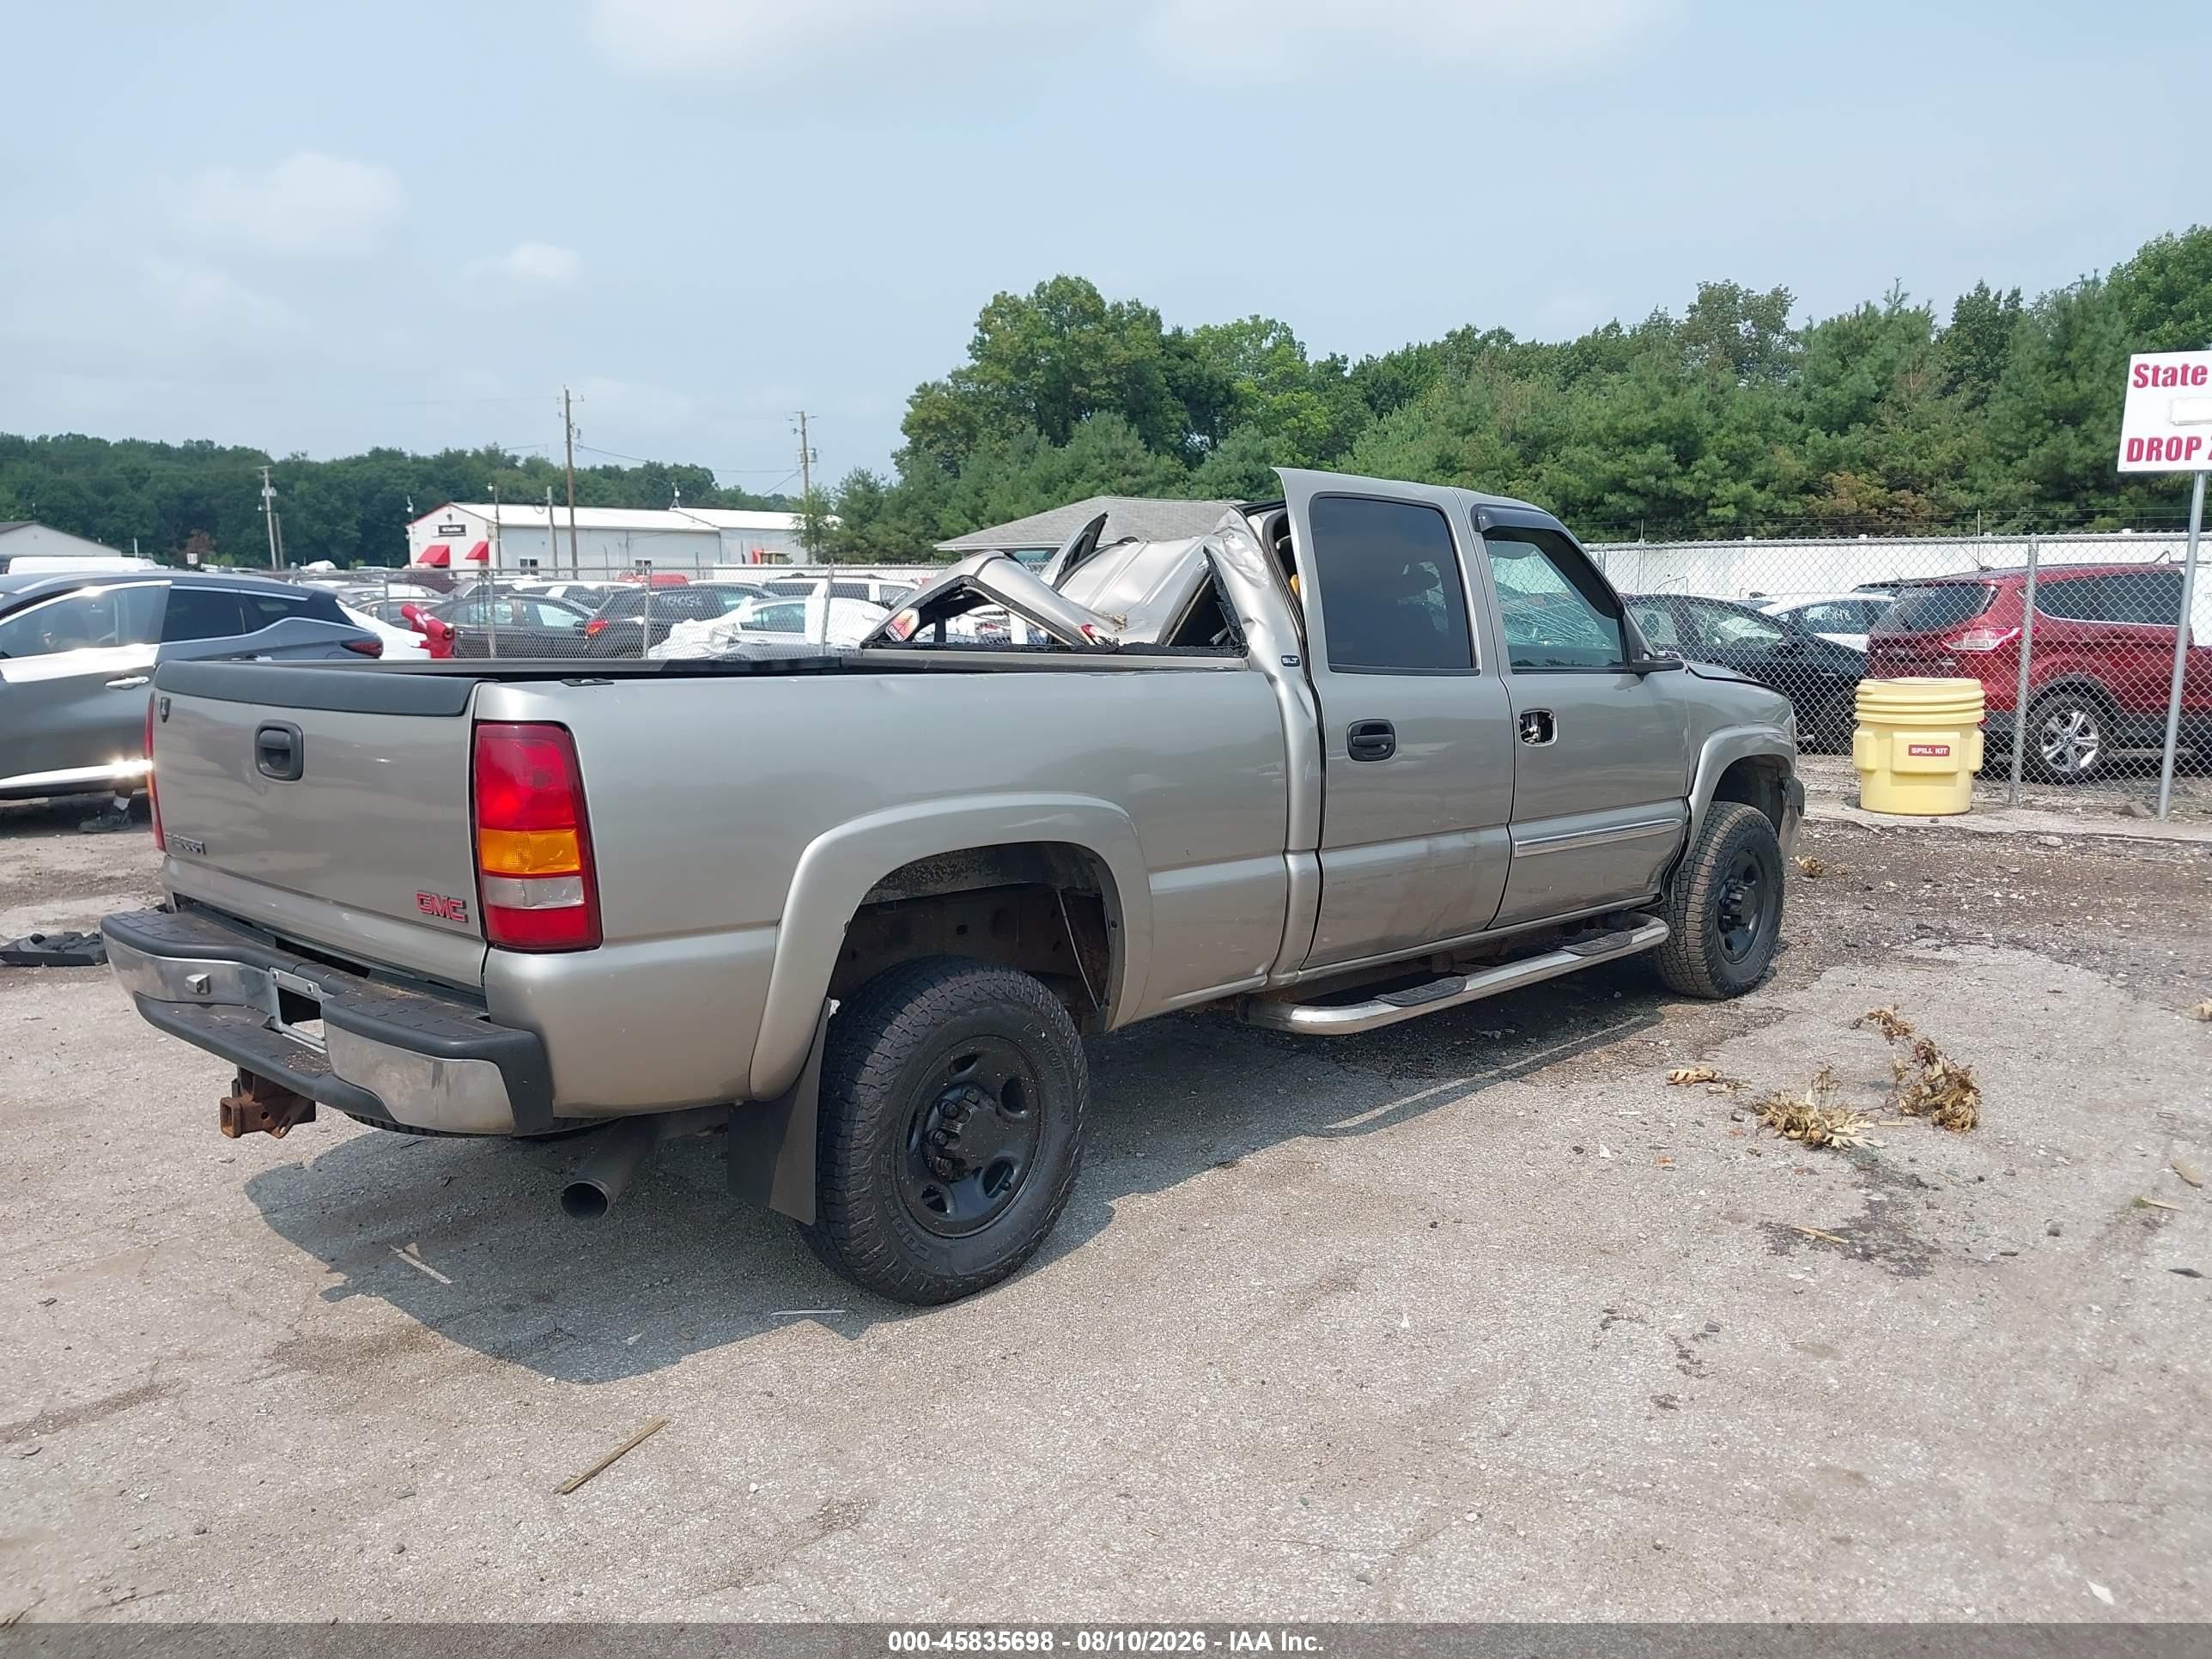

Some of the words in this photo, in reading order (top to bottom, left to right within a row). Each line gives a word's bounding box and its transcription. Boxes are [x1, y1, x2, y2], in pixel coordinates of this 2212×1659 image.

[2133, 363, 2208, 388] State
[2127, 436, 2203, 462] DROP
[416, 892, 467, 922] GMC
